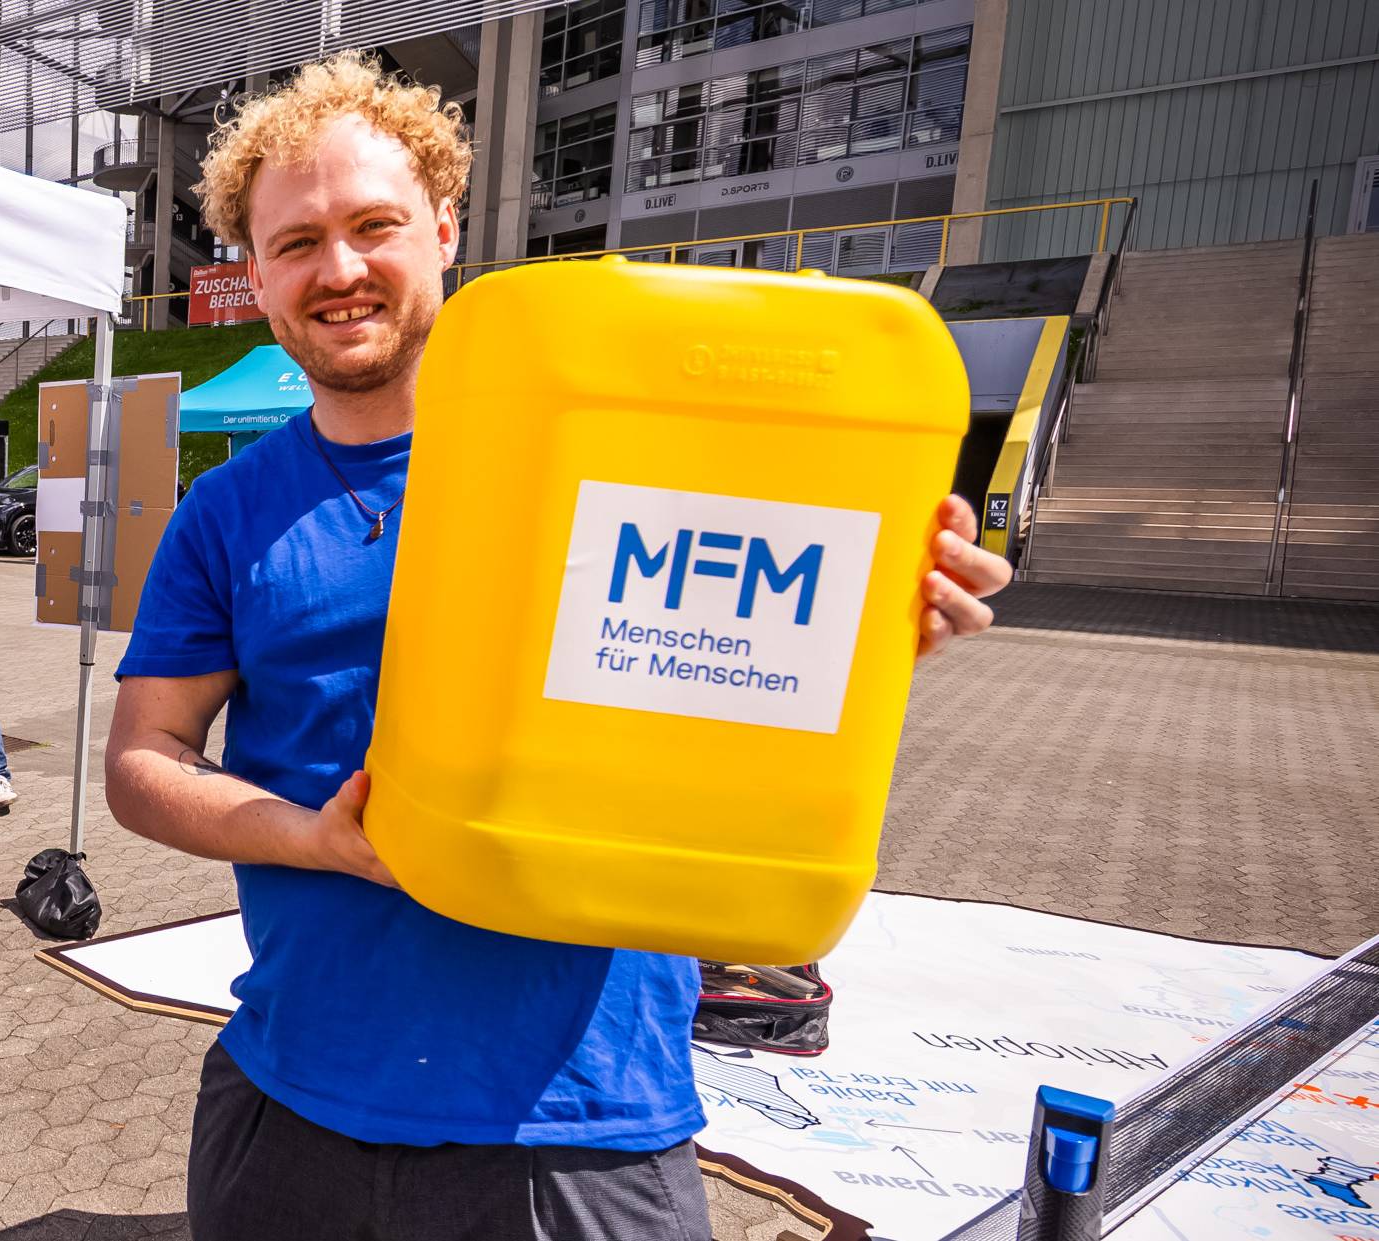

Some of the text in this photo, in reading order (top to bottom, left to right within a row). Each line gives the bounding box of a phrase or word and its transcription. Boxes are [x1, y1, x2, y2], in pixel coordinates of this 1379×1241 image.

[926, 153, 958, 168] D.LIV
[721, 182, 769, 196] D.SPORTS
[645, 195, 675, 210] D.LIVE
[223, 415, 237, 424] Der
[991, 500, 1008, 510] K7
[992, 517, 1006, 527] -2
[608, 522, 825, 625] MFM
[600, 616, 752, 657] Menschen
[596, 647, 799, 694] für Menschen
[789, 1066, 977, 1095] mit Erer-Tal
[810, 1082, 916, 1107] Babile
[833, 1170, 951, 1199] Dawa
